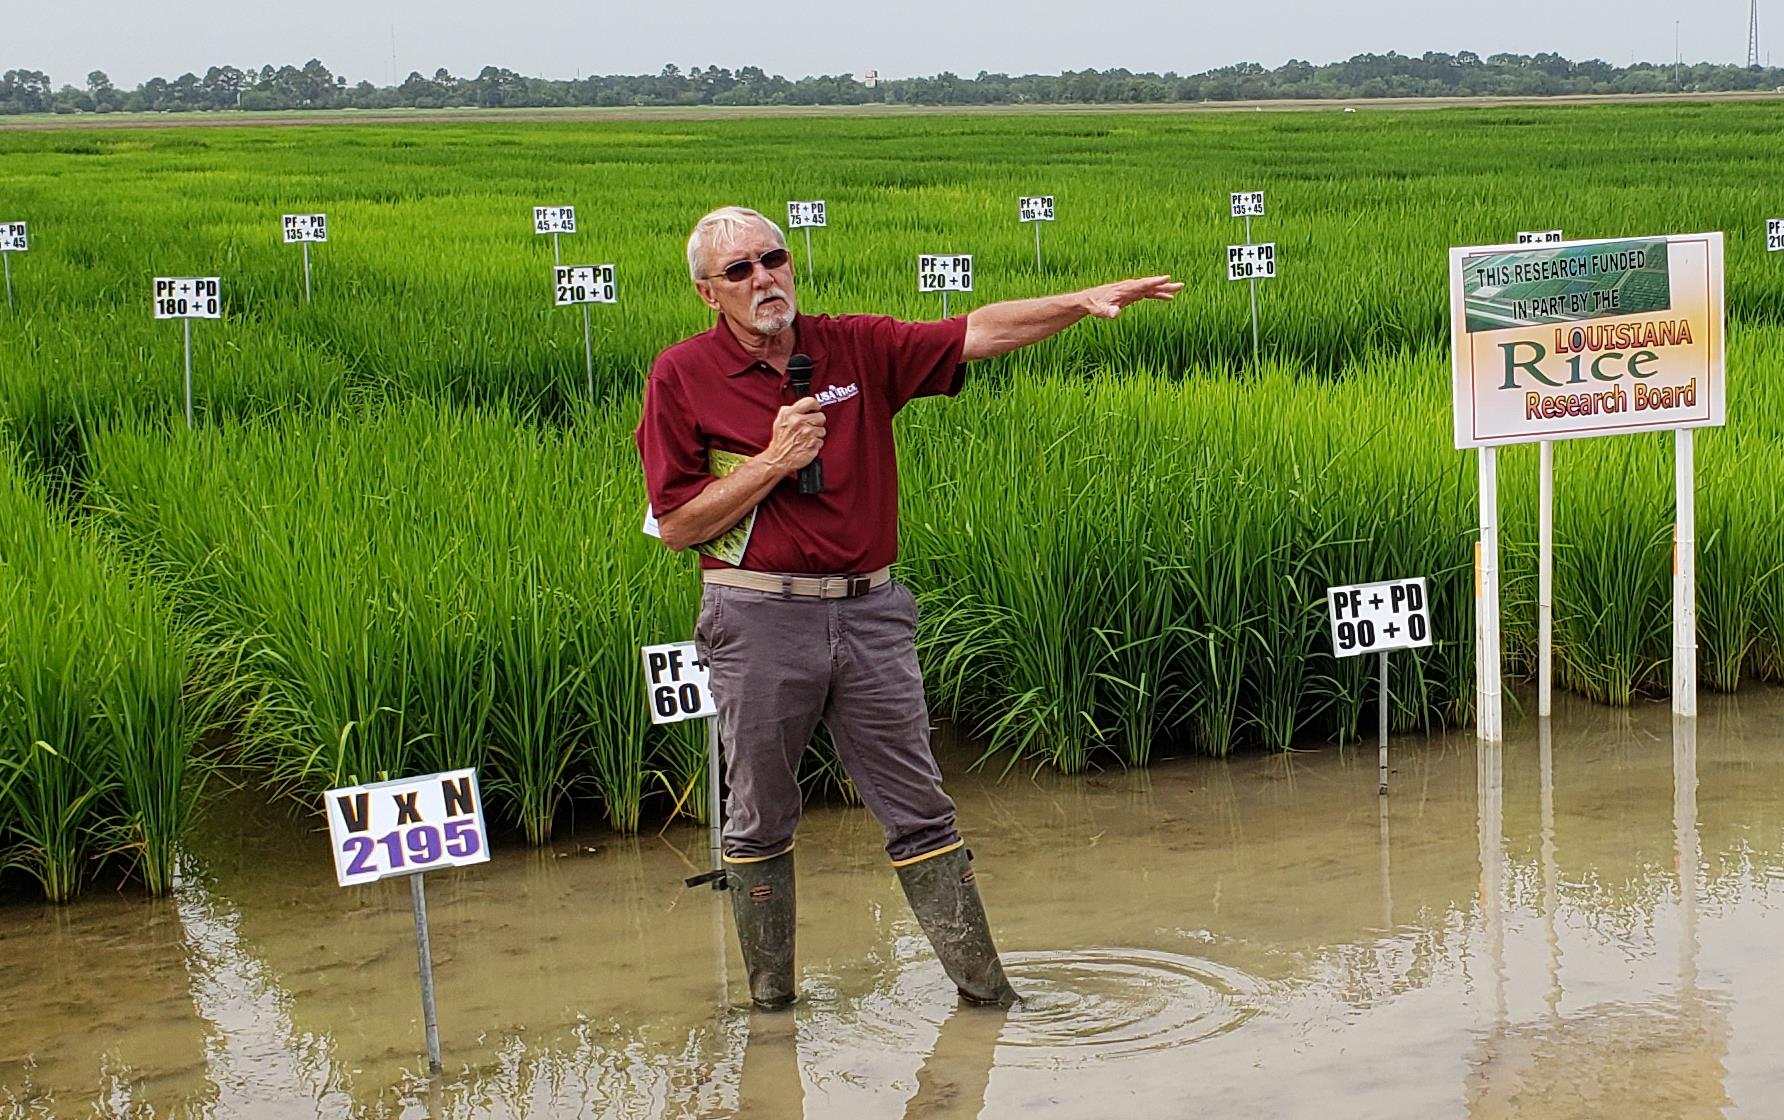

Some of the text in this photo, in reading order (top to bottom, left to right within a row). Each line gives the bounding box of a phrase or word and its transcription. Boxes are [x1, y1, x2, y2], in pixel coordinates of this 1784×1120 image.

[1021, 198, 1031, 208] PF
[1041, 197, 1052, 208] PD
[1232, 194, 1242, 204] PF
[1251, 194, 1262, 204] PD
[536, 209, 548, 220] PF
[560, 209, 572, 219] PD
[790, 204, 800, 214] PF
[811, 203, 823, 213] PD
[1022, 209, 1035, 219] 105
[1044, 208, 1053, 218] 45
[1233, 205, 1245, 214] 135
[1254, 204, 1262, 213] 45
[285, 216, 297, 228] PF
[310, 216, 324, 227] PD
[537, 220, 550, 231] 45
[561, 220, 573, 230] 45
[790, 215, 801, 225] 75
[812, 214, 824, 224] 45
[9, 225, 24, 236] PD
[286, 229, 303, 240] 135
[313, 228, 325, 239] 45
[1769, 222, 1780, 234] PF
[13, 237, 26, 248] 45
[1230, 246, 1273, 262] PF + PD
[921, 258, 970, 272] PF + PD
[1230, 261, 1274, 277] 150 + 0
[1476, 250, 1645, 288] THIS RESEARCH FUNDED
[557, 268, 612, 284] PF + PD
[921, 274, 970, 288] 120 + 0
[157, 281, 216, 297] PF + PD
[558, 285, 613, 301] 210 + 0
[157, 298, 217, 314] 180 + 0
[1512, 289, 1619, 320] IN PART BY THE
[1555, 320, 1693, 354] LOUISIANA
[1497, 340, 1660, 390] Rice
[1525, 378, 1696, 420] Research Board
[1333, 584, 1423, 620] PF + PD
[1337, 614, 1426, 650] 90 + 0
[648, 650, 683, 684] PF
[655, 683, 701, 717] 60
[337, 792, 369, 833] V
[442, 777, 474, 817] N
[342, 819, 480, 876] 2195
